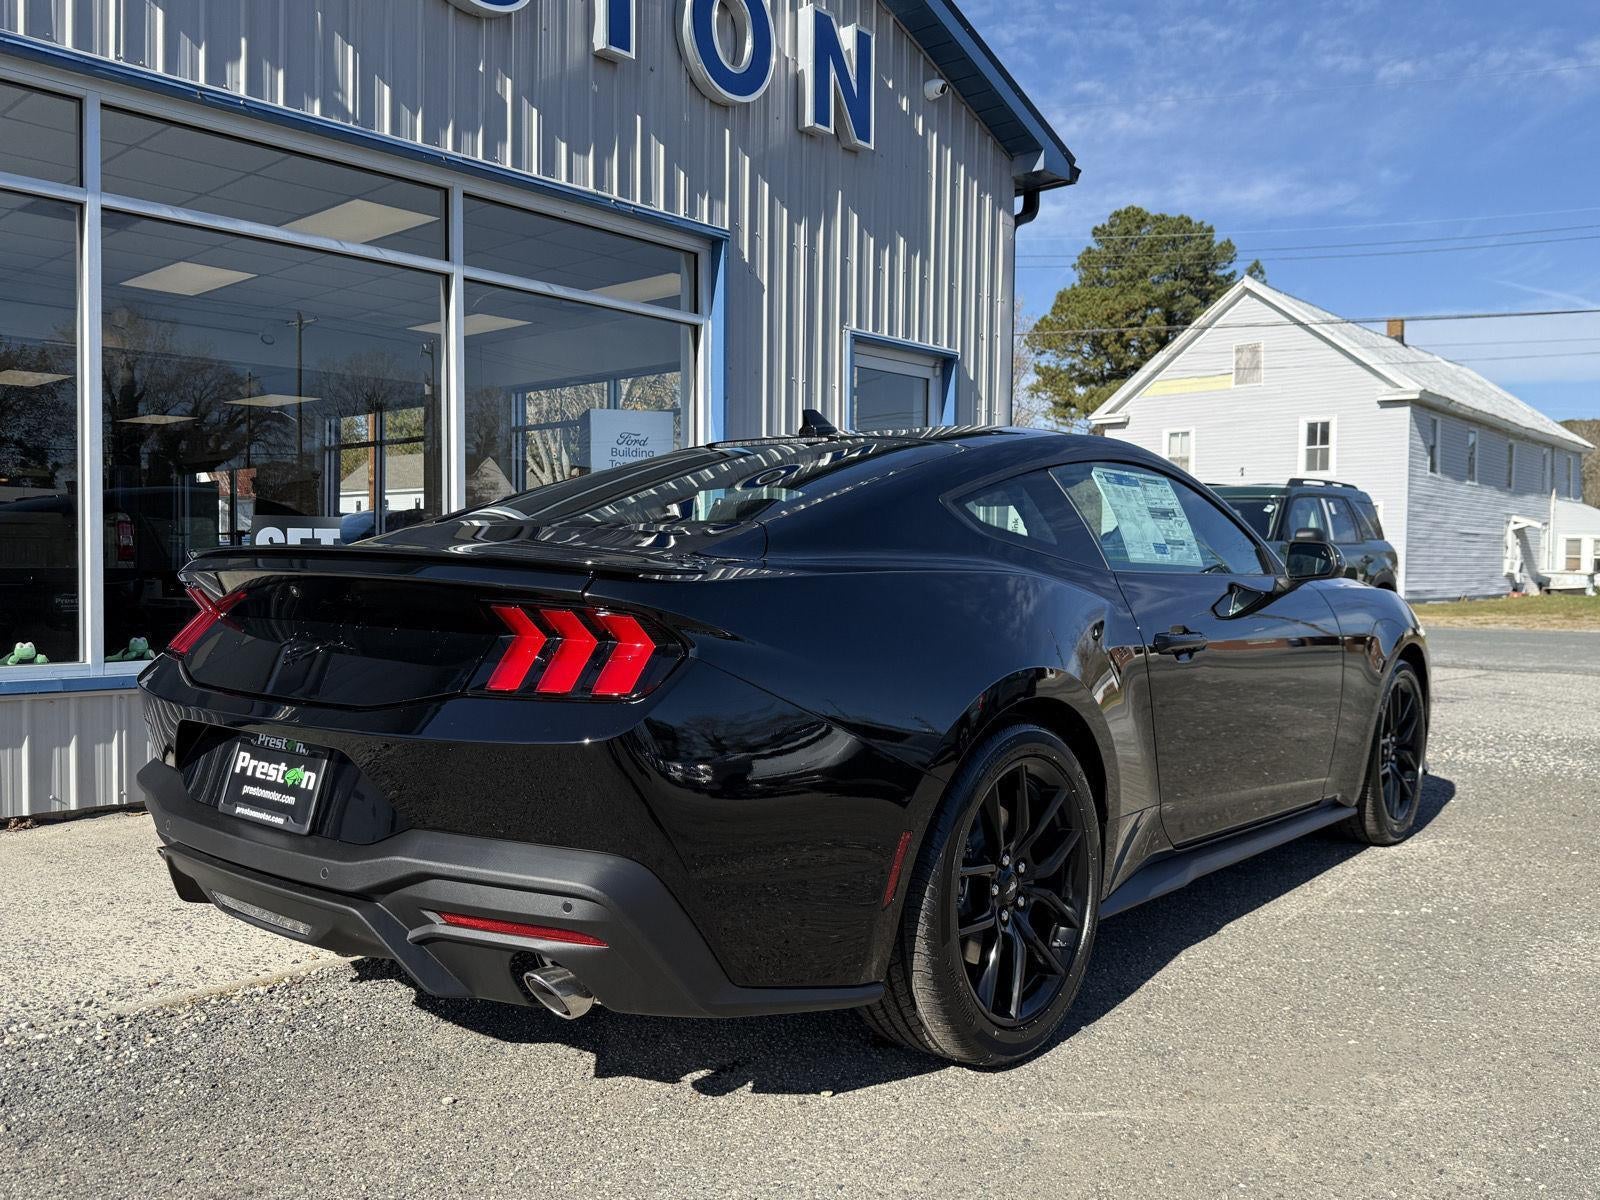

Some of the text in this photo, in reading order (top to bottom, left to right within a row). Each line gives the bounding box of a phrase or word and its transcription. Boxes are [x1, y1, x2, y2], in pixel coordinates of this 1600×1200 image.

[616, 432, 648, 446] Ford
[611, 447, 655, 458] Building
[242, 785, 296, 805] prestonmotor.com
[235, 806, 284, 825] prestonmotor.com
